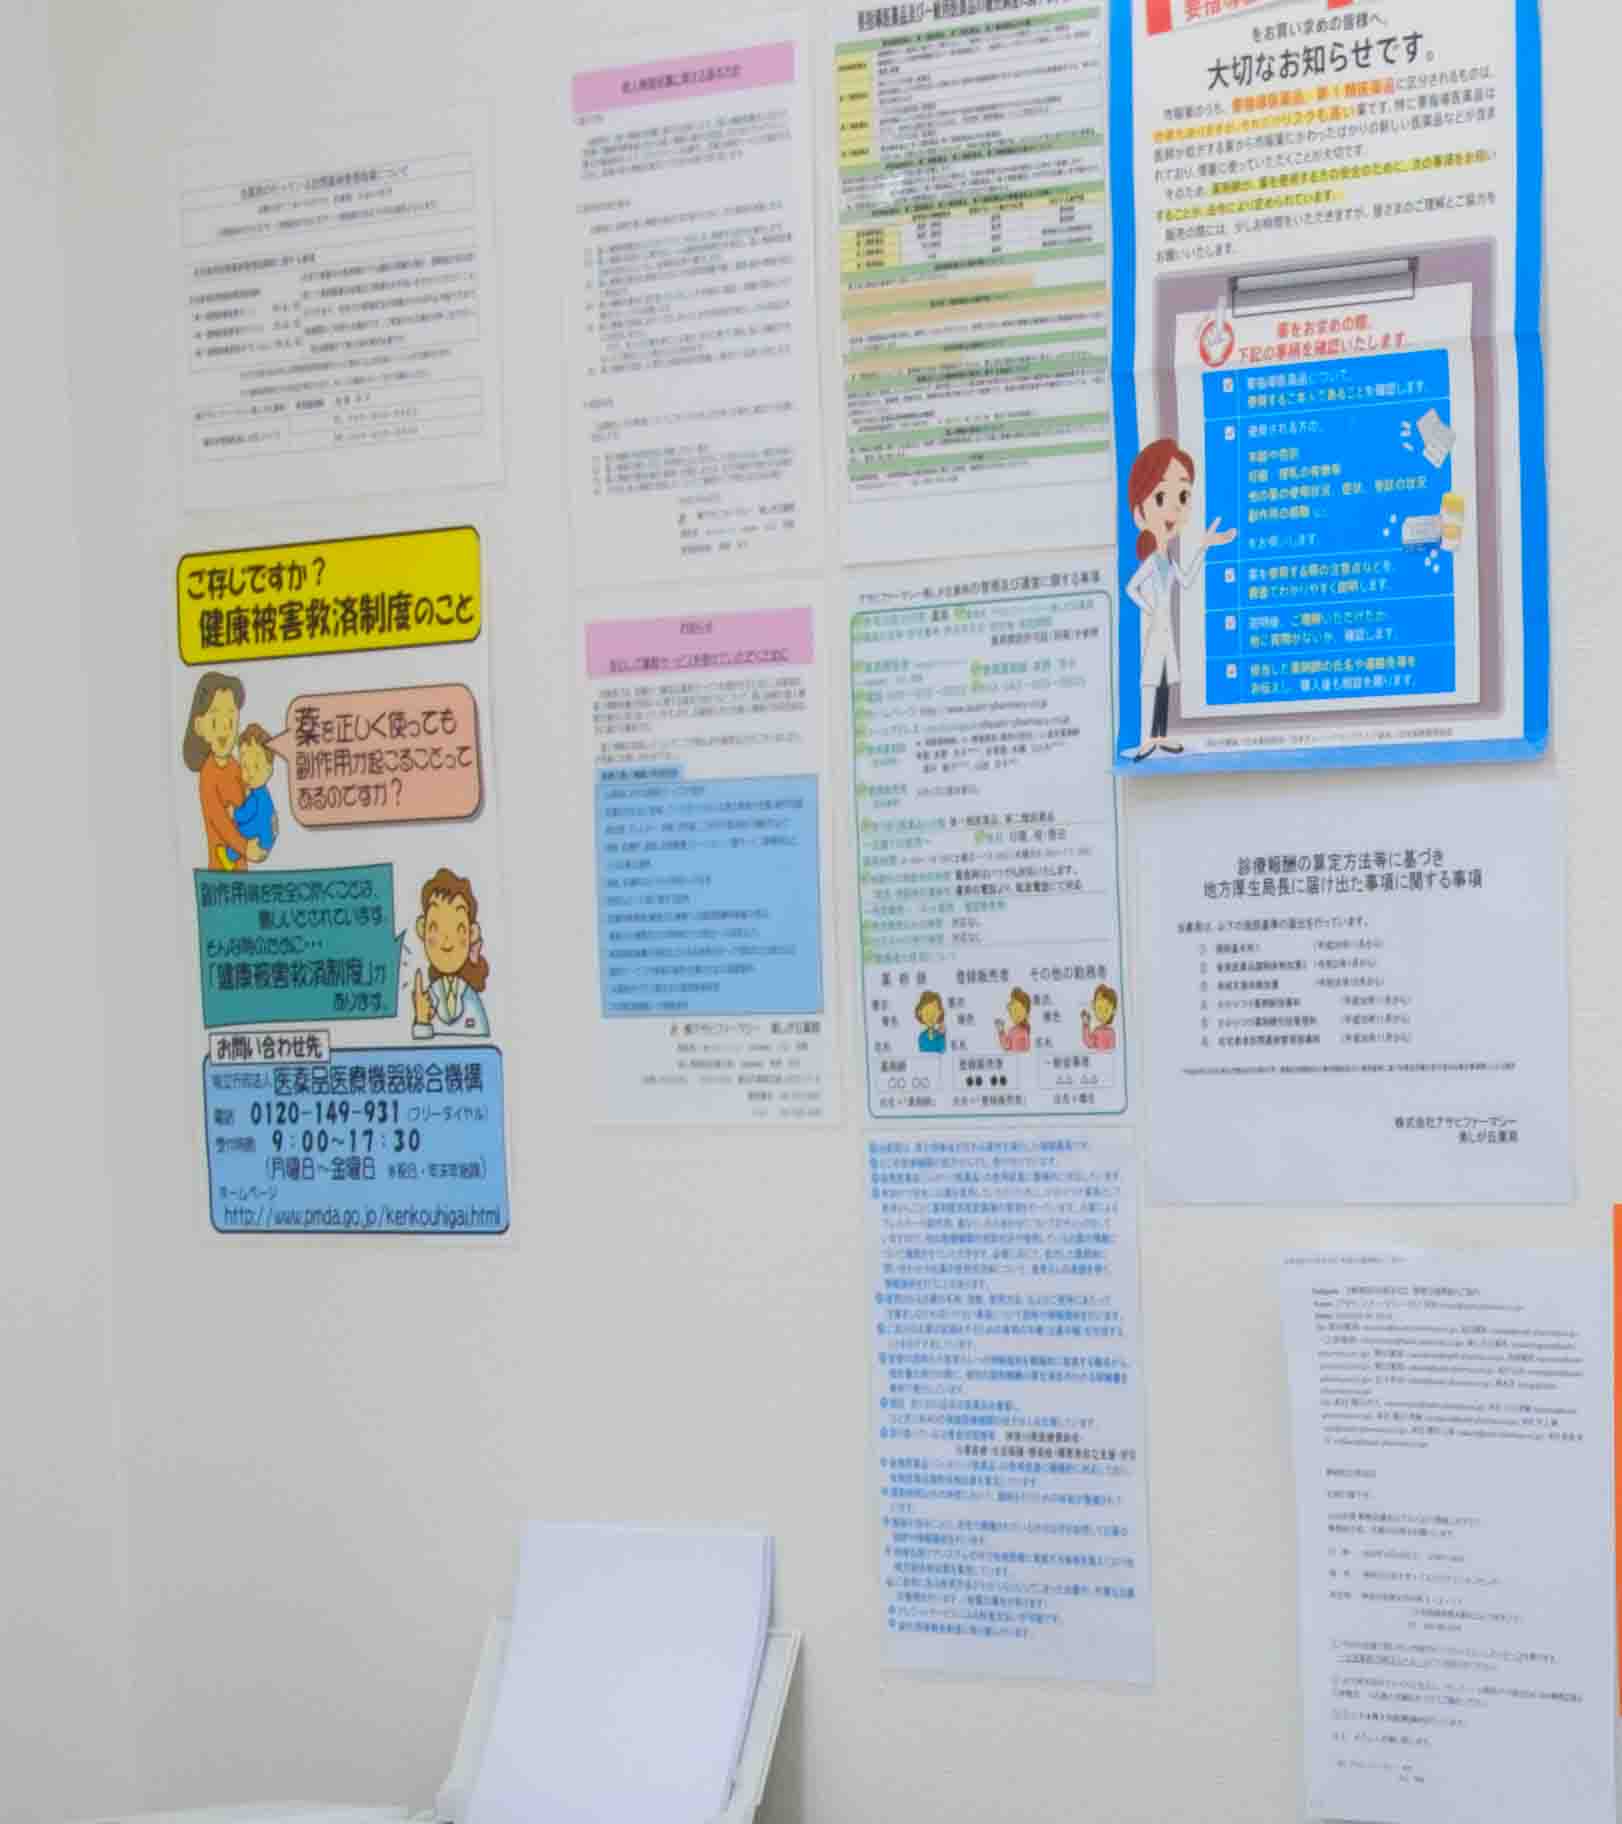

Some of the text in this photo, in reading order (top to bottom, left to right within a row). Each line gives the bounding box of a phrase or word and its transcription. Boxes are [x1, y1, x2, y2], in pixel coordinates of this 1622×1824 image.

[1207, 32, 1435, 91] 大切なお知らせです。
[186, 557, 326, 600] ご存じですか？
[200, 592, 473, 648] 健康被害救済制度のこと
[296, 707, 458, 745] 薬を正しく使っても
[215, 1033, 324, 1058] お問い合わせ先
[273, 1063, 483, 1097] 医薬品医療機器総合機構
[250, 1099, 402, 1127] 0120-149-931
